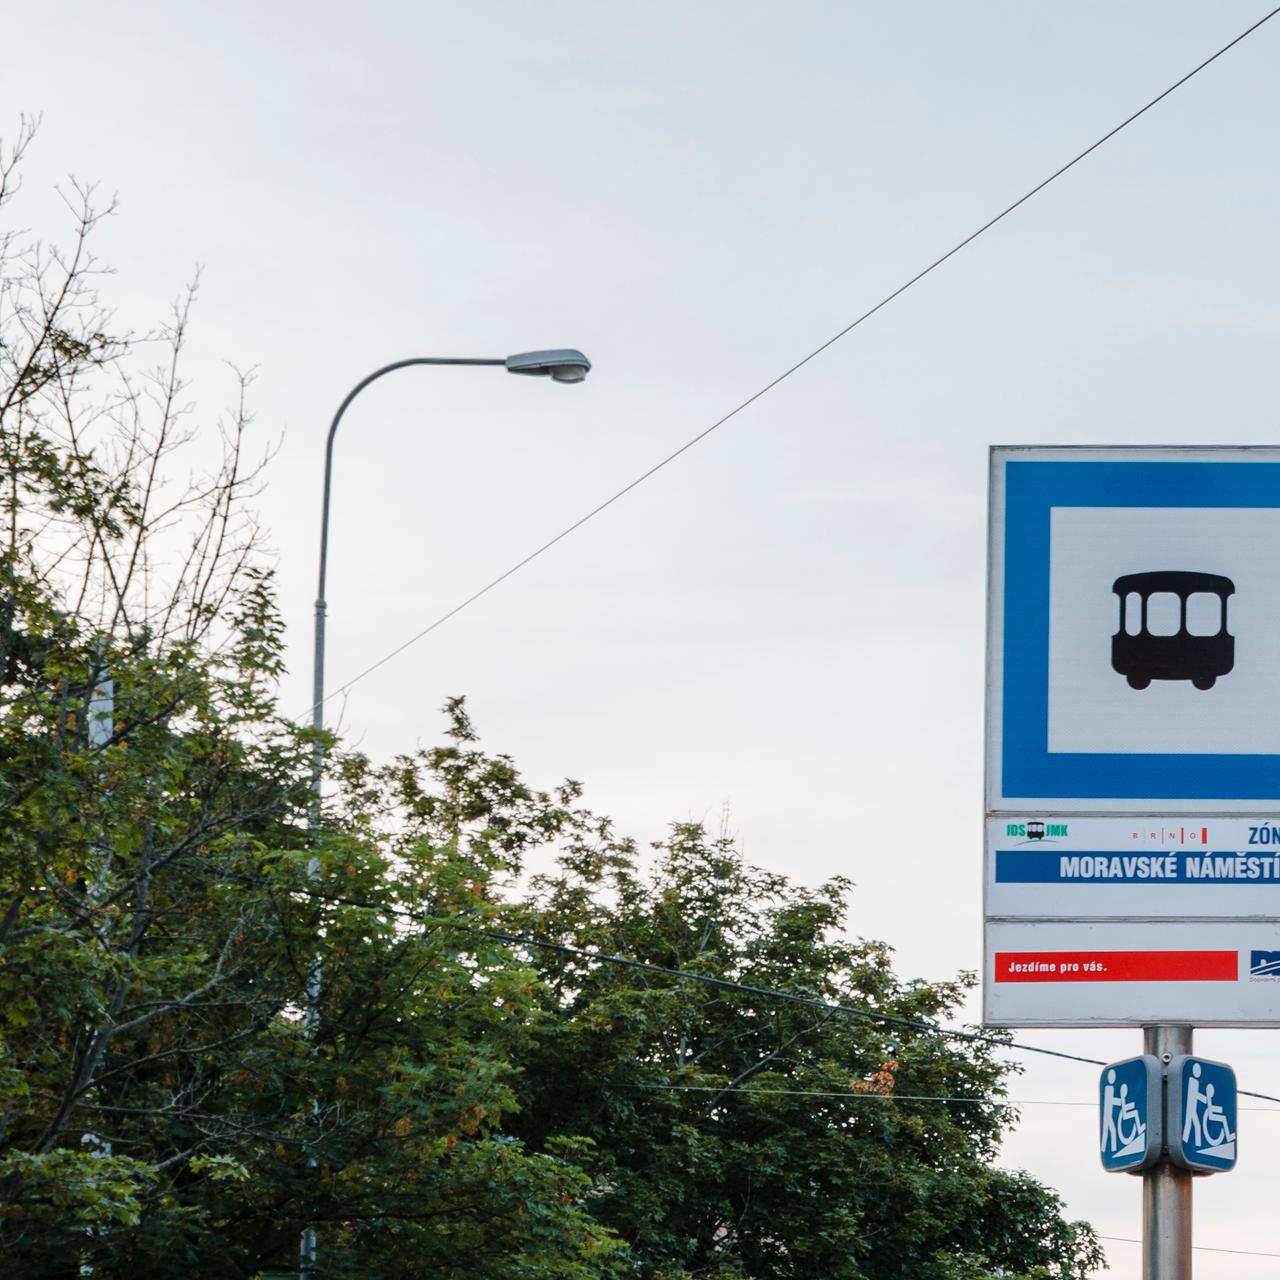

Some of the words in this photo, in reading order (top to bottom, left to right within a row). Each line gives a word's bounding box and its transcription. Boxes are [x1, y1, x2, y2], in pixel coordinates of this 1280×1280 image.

[1006, 824, 1026, 837] IDS
[1046, 824, 1069, 837] JMK
[1059, 852, 1178, 879] MORAVSKÉ
[1008, 961, 1057, 973] Jezdíme
[1060, 962, 1079, 974] pro
[1082, 961, 1108, 972] vás.
